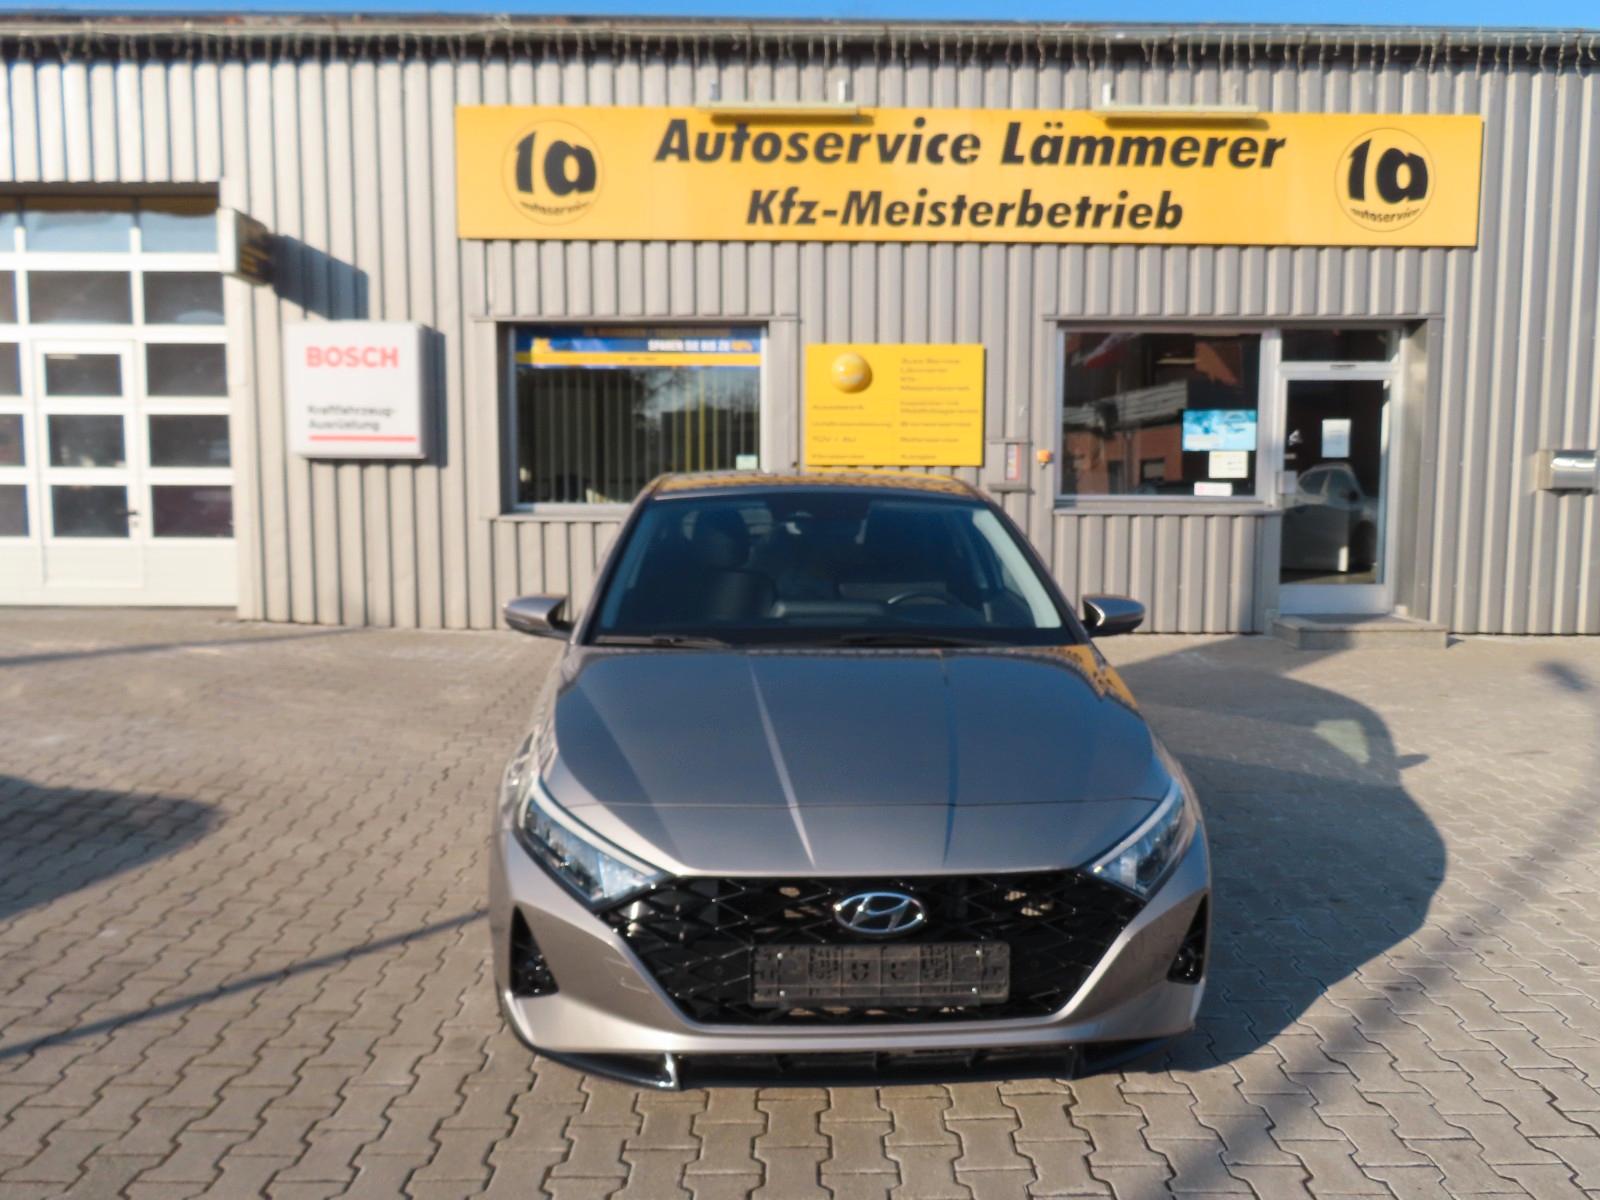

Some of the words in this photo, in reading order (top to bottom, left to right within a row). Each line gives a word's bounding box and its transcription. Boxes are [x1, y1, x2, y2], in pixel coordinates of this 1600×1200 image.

[654, 116, 981, 164] Autoservice
[1002, 121, 1285, 168] Lämmerer
[747, 187, 1183, 230] Kfz-Meisterbetrieb
[305, 345, 400, 369] BOSCH
